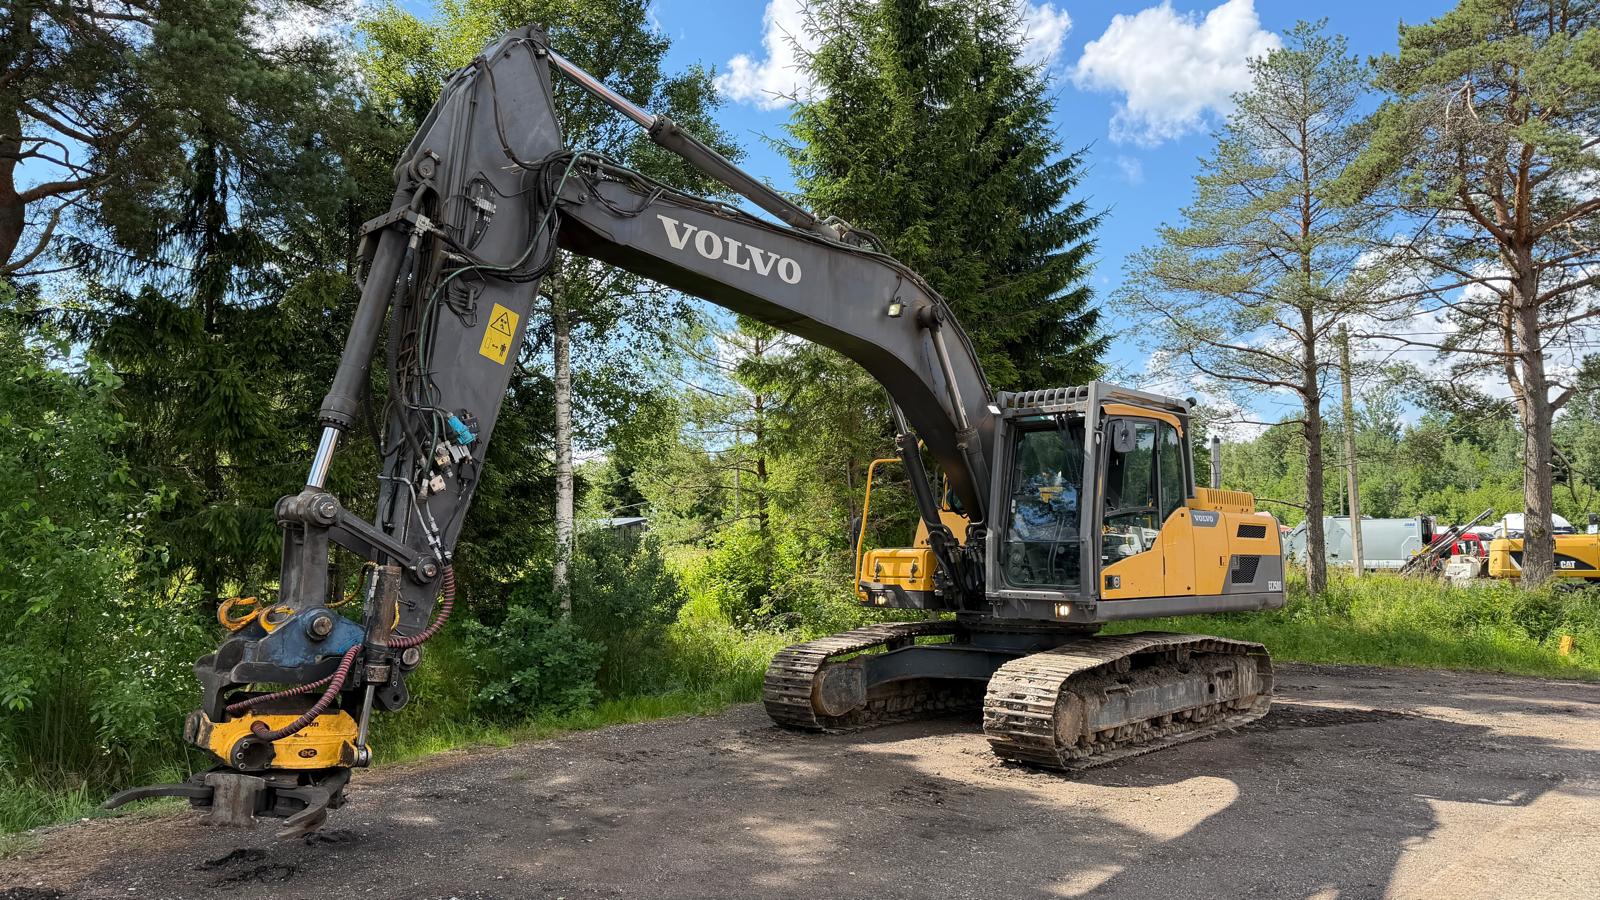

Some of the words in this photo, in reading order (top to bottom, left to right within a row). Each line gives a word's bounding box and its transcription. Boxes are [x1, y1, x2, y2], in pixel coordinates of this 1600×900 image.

[656, 214, 802, 285] VOLVO
[1193, 514, 1214, 522] VOLVO
[1560, 560, 1576, 569] CAT
